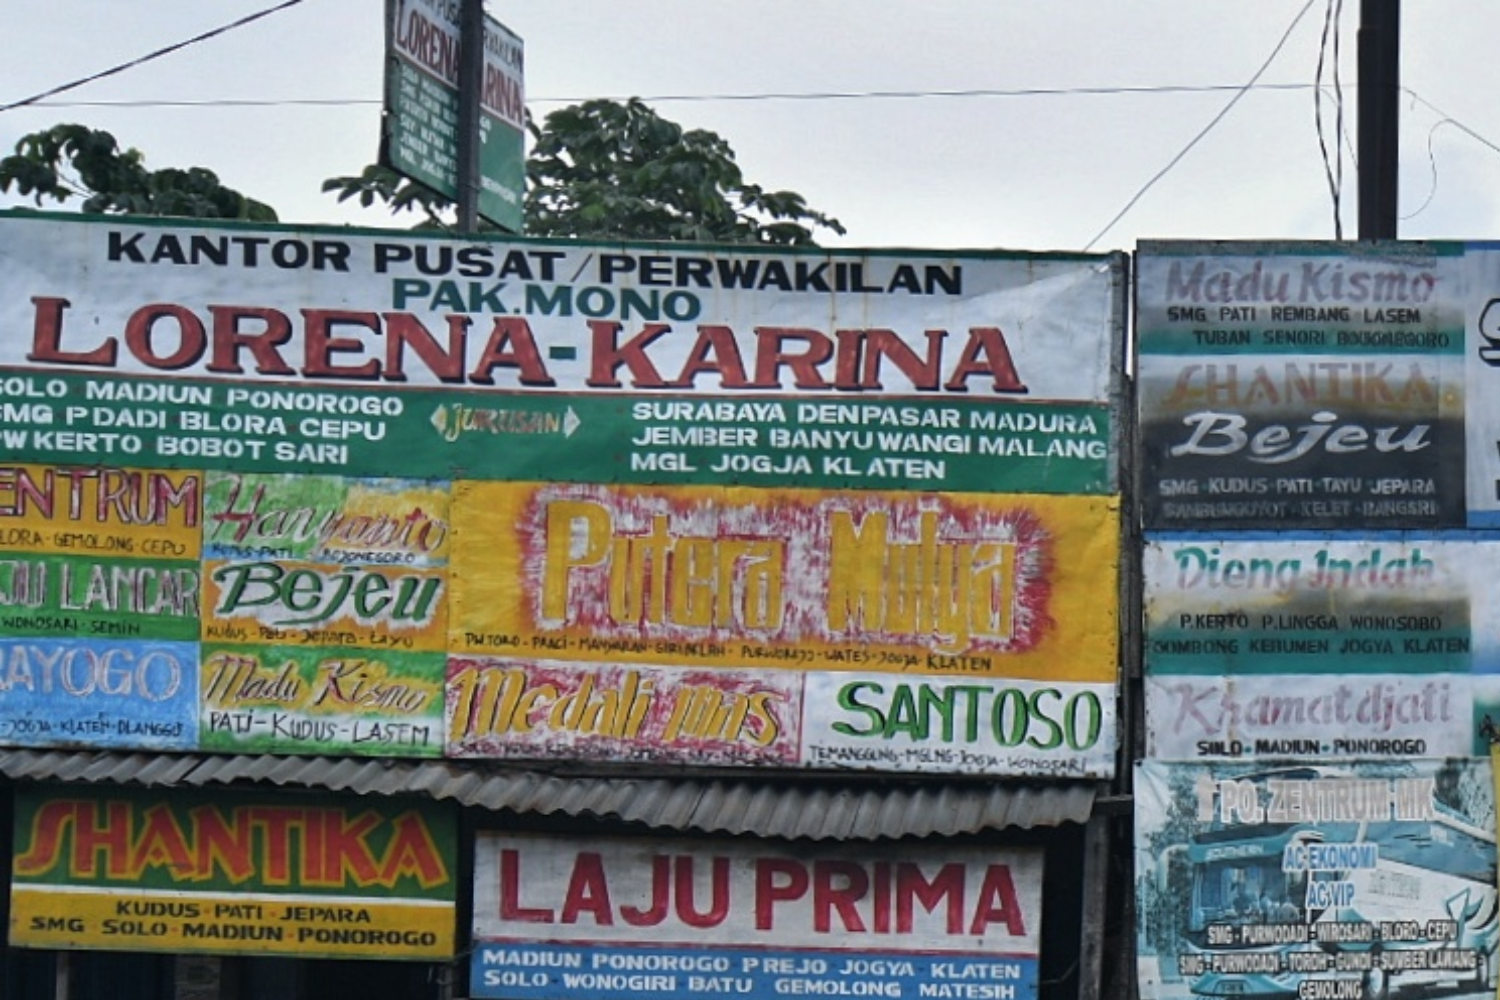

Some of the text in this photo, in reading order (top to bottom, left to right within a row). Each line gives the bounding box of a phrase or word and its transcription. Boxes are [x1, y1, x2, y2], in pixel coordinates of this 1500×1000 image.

[108, 230, 351, 273] KANTOR
[1166, 259, 1442, 304] Madu Kismo
[1168, 306, 1421, 323] SMG PATI REMBANG LASEM
[1193, 331, 1251, 345] TUBAN
[86, 380, 403, 416] MADIUN PONOROGO
[180, 411, 386, 442] BLORA CEPU
[632, 402, 1097, 435] SURABAYA DENPASAR MADURA
[632, 427, 1108, 460] JEMBER BANYUWANGI MALANG
[1170, 410, 1431, 464] Bejeu
[631, 453, 946, 480] MGL JOGJA KLATEN
[1159, 479, 1198, 496] SMG
[1208, 477, 1268, 494] KUDUS
[1276, 478, 1313, 494] PATI
[1370, 478, 1435, 494] JEPARA
[212, 561, 442, 626] Bejeu
[1351, 614, 1442, 632] WONOSOBO
[927, 653, 992, 671] KLATEN
[271, 713, 430, 746] KUDUS LASEM
[832, 680, 1102, 751] SANTOSO
[12, 800, 450, 888] SHANTIKA
[499, 848, 1027, 938] LAJU PRIMA
[116, 900, 371, 924] KUDUS PATI JEPARA
[30, 915, 437, 947] SMG SOLO MADIUN PONOROGO
[482, 949, 1020, 980] MADIUN PONOROGO JOGYA KLATEN
[484, 970, 1015, 1000] SOLO WONOGIRI BATU GEMOLONG MATESIH
